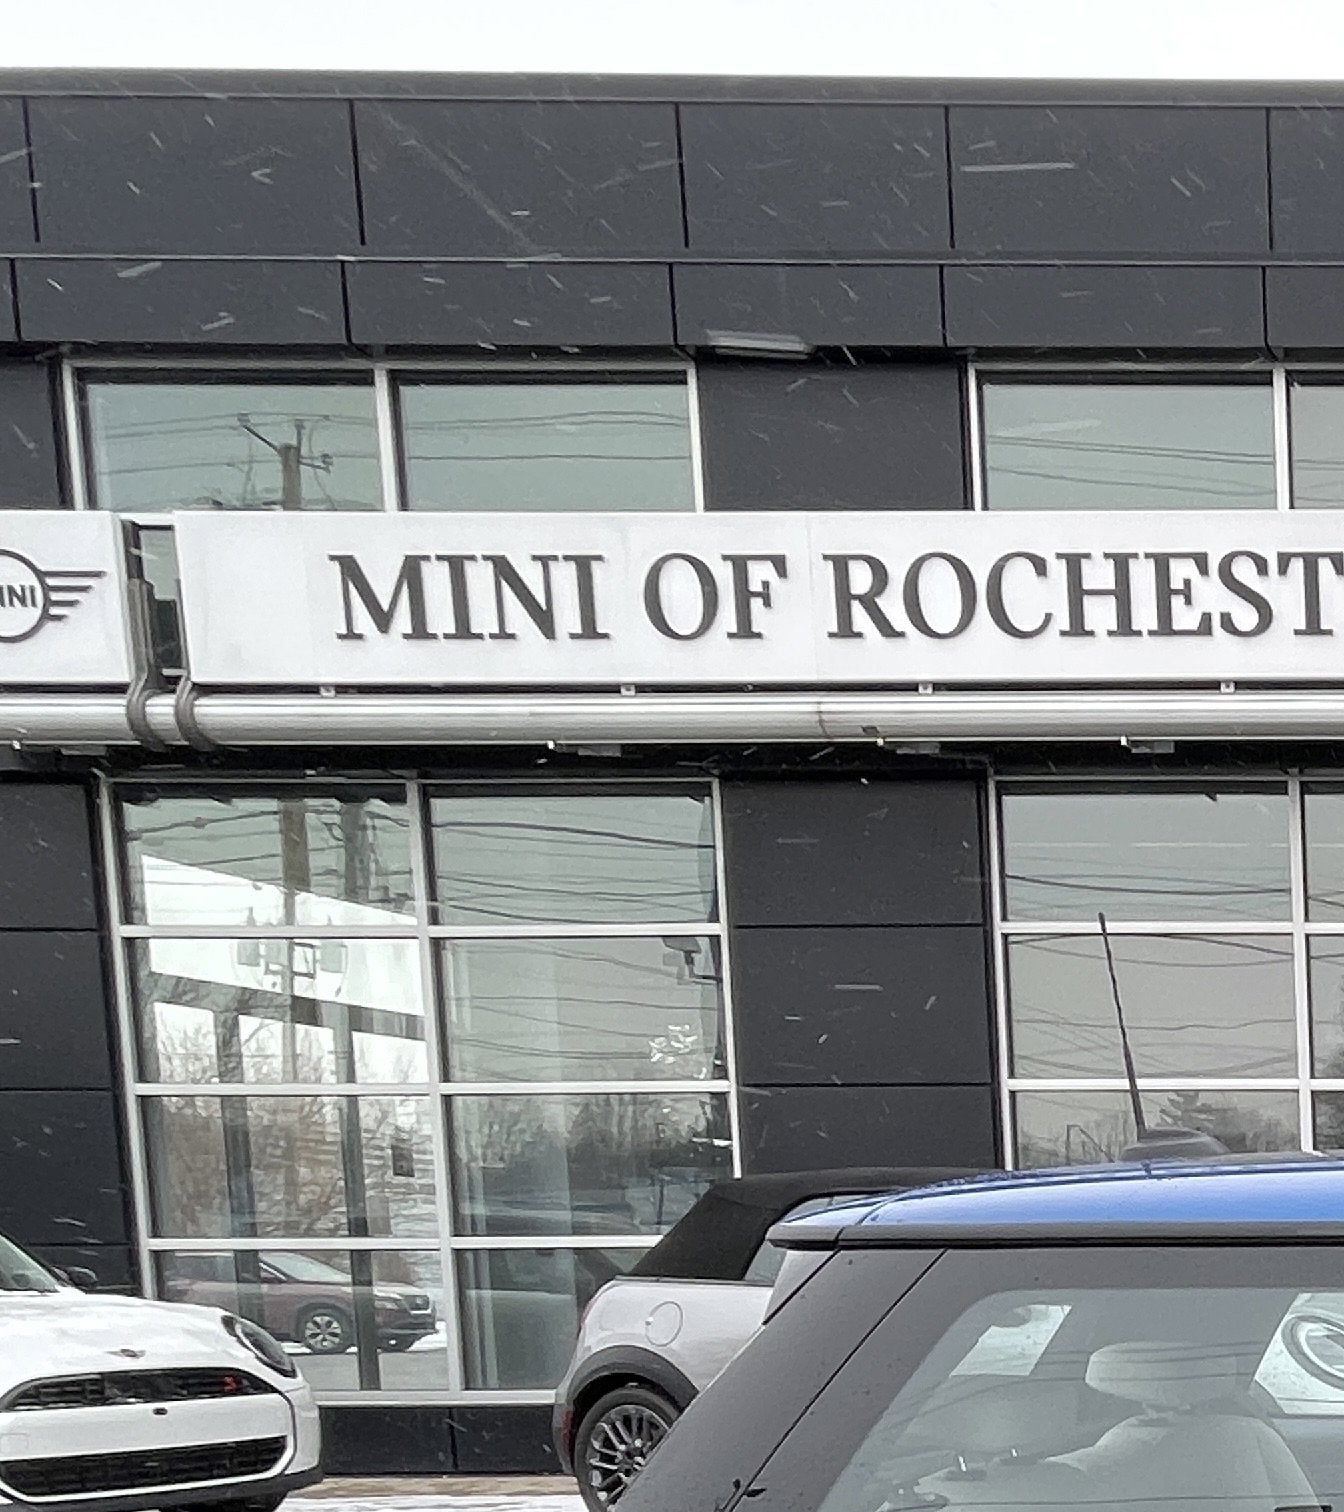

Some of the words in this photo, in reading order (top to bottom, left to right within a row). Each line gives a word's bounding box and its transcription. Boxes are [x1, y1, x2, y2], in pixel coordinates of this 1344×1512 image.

[0, 584, 38, 608] INI
[329, 553, 610, 640] MINI
[643, 552, 788, 641] OF
